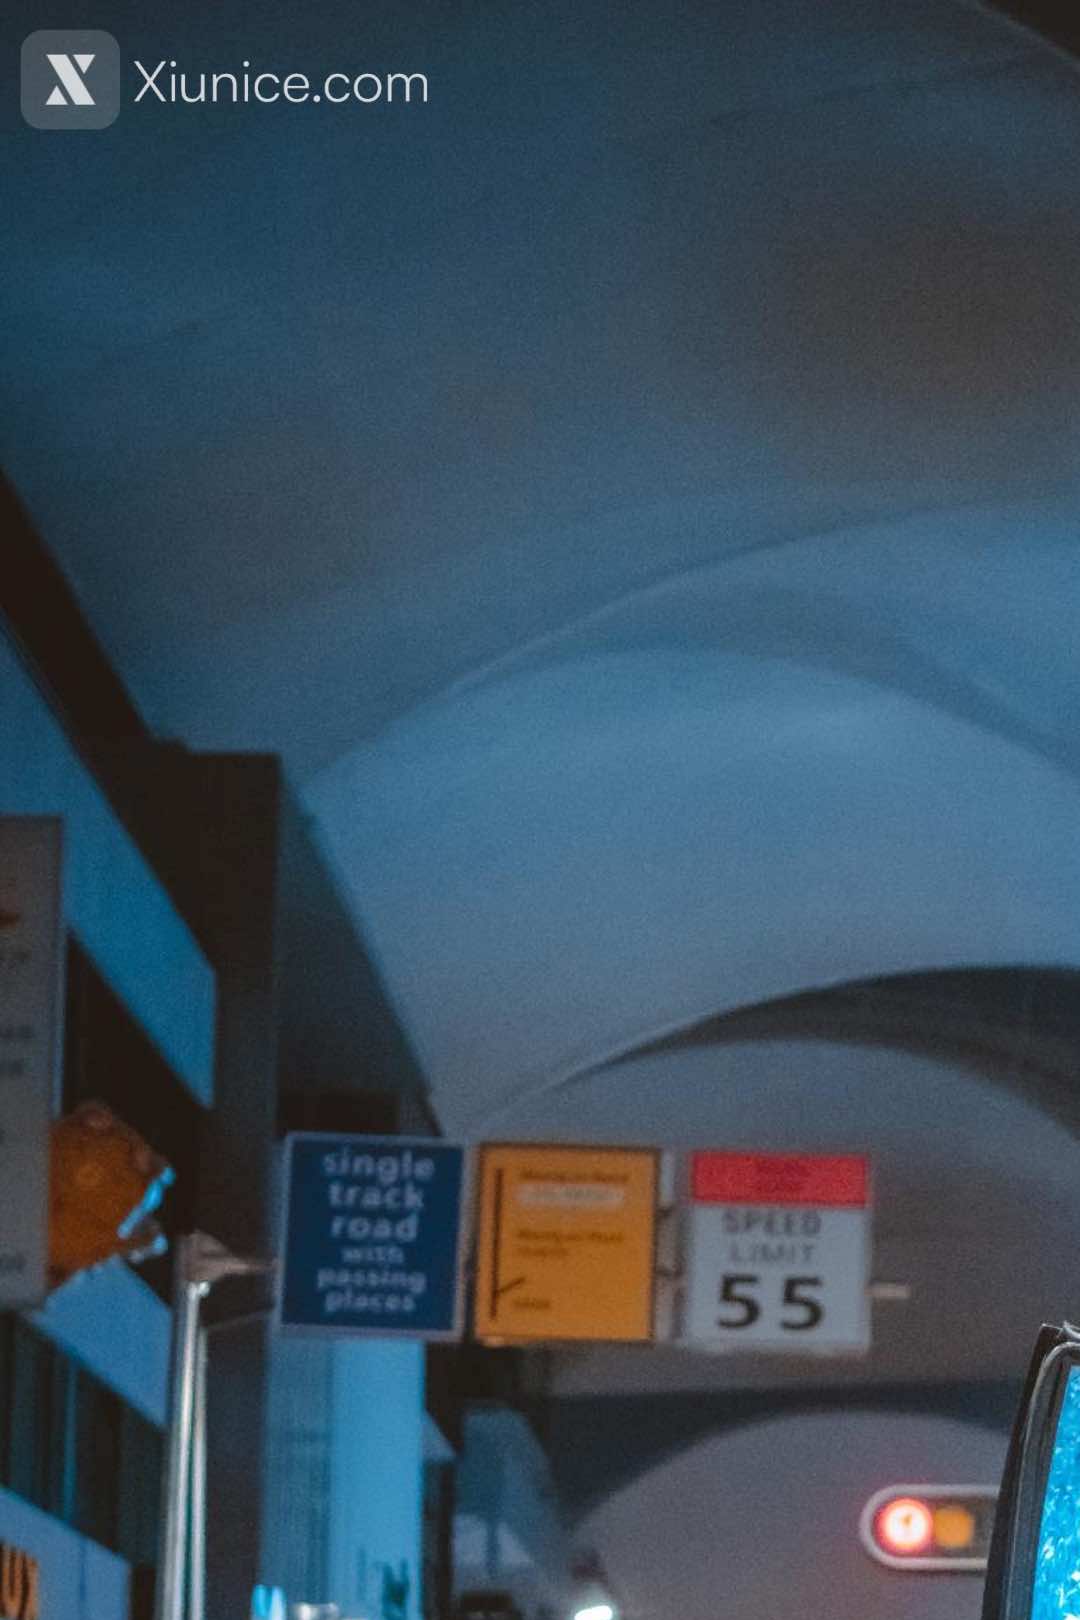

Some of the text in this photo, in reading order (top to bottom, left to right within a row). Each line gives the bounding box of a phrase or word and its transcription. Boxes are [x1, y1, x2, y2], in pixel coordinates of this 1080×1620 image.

[323, 1147, 435, 1183] single
[329, 1179, 425, 1209] track
[330, 1210, 420, 1241] road
[722, 1210, 822, 1235] SPEED
[341, 1244, 404, 1264] with
[729, 1243, 815, 1263] LIMIT
[317, 1267, 426, 1294] passing
[324, 1287, 416, 1313] places
[716, 1273, 825, 1330] 55
